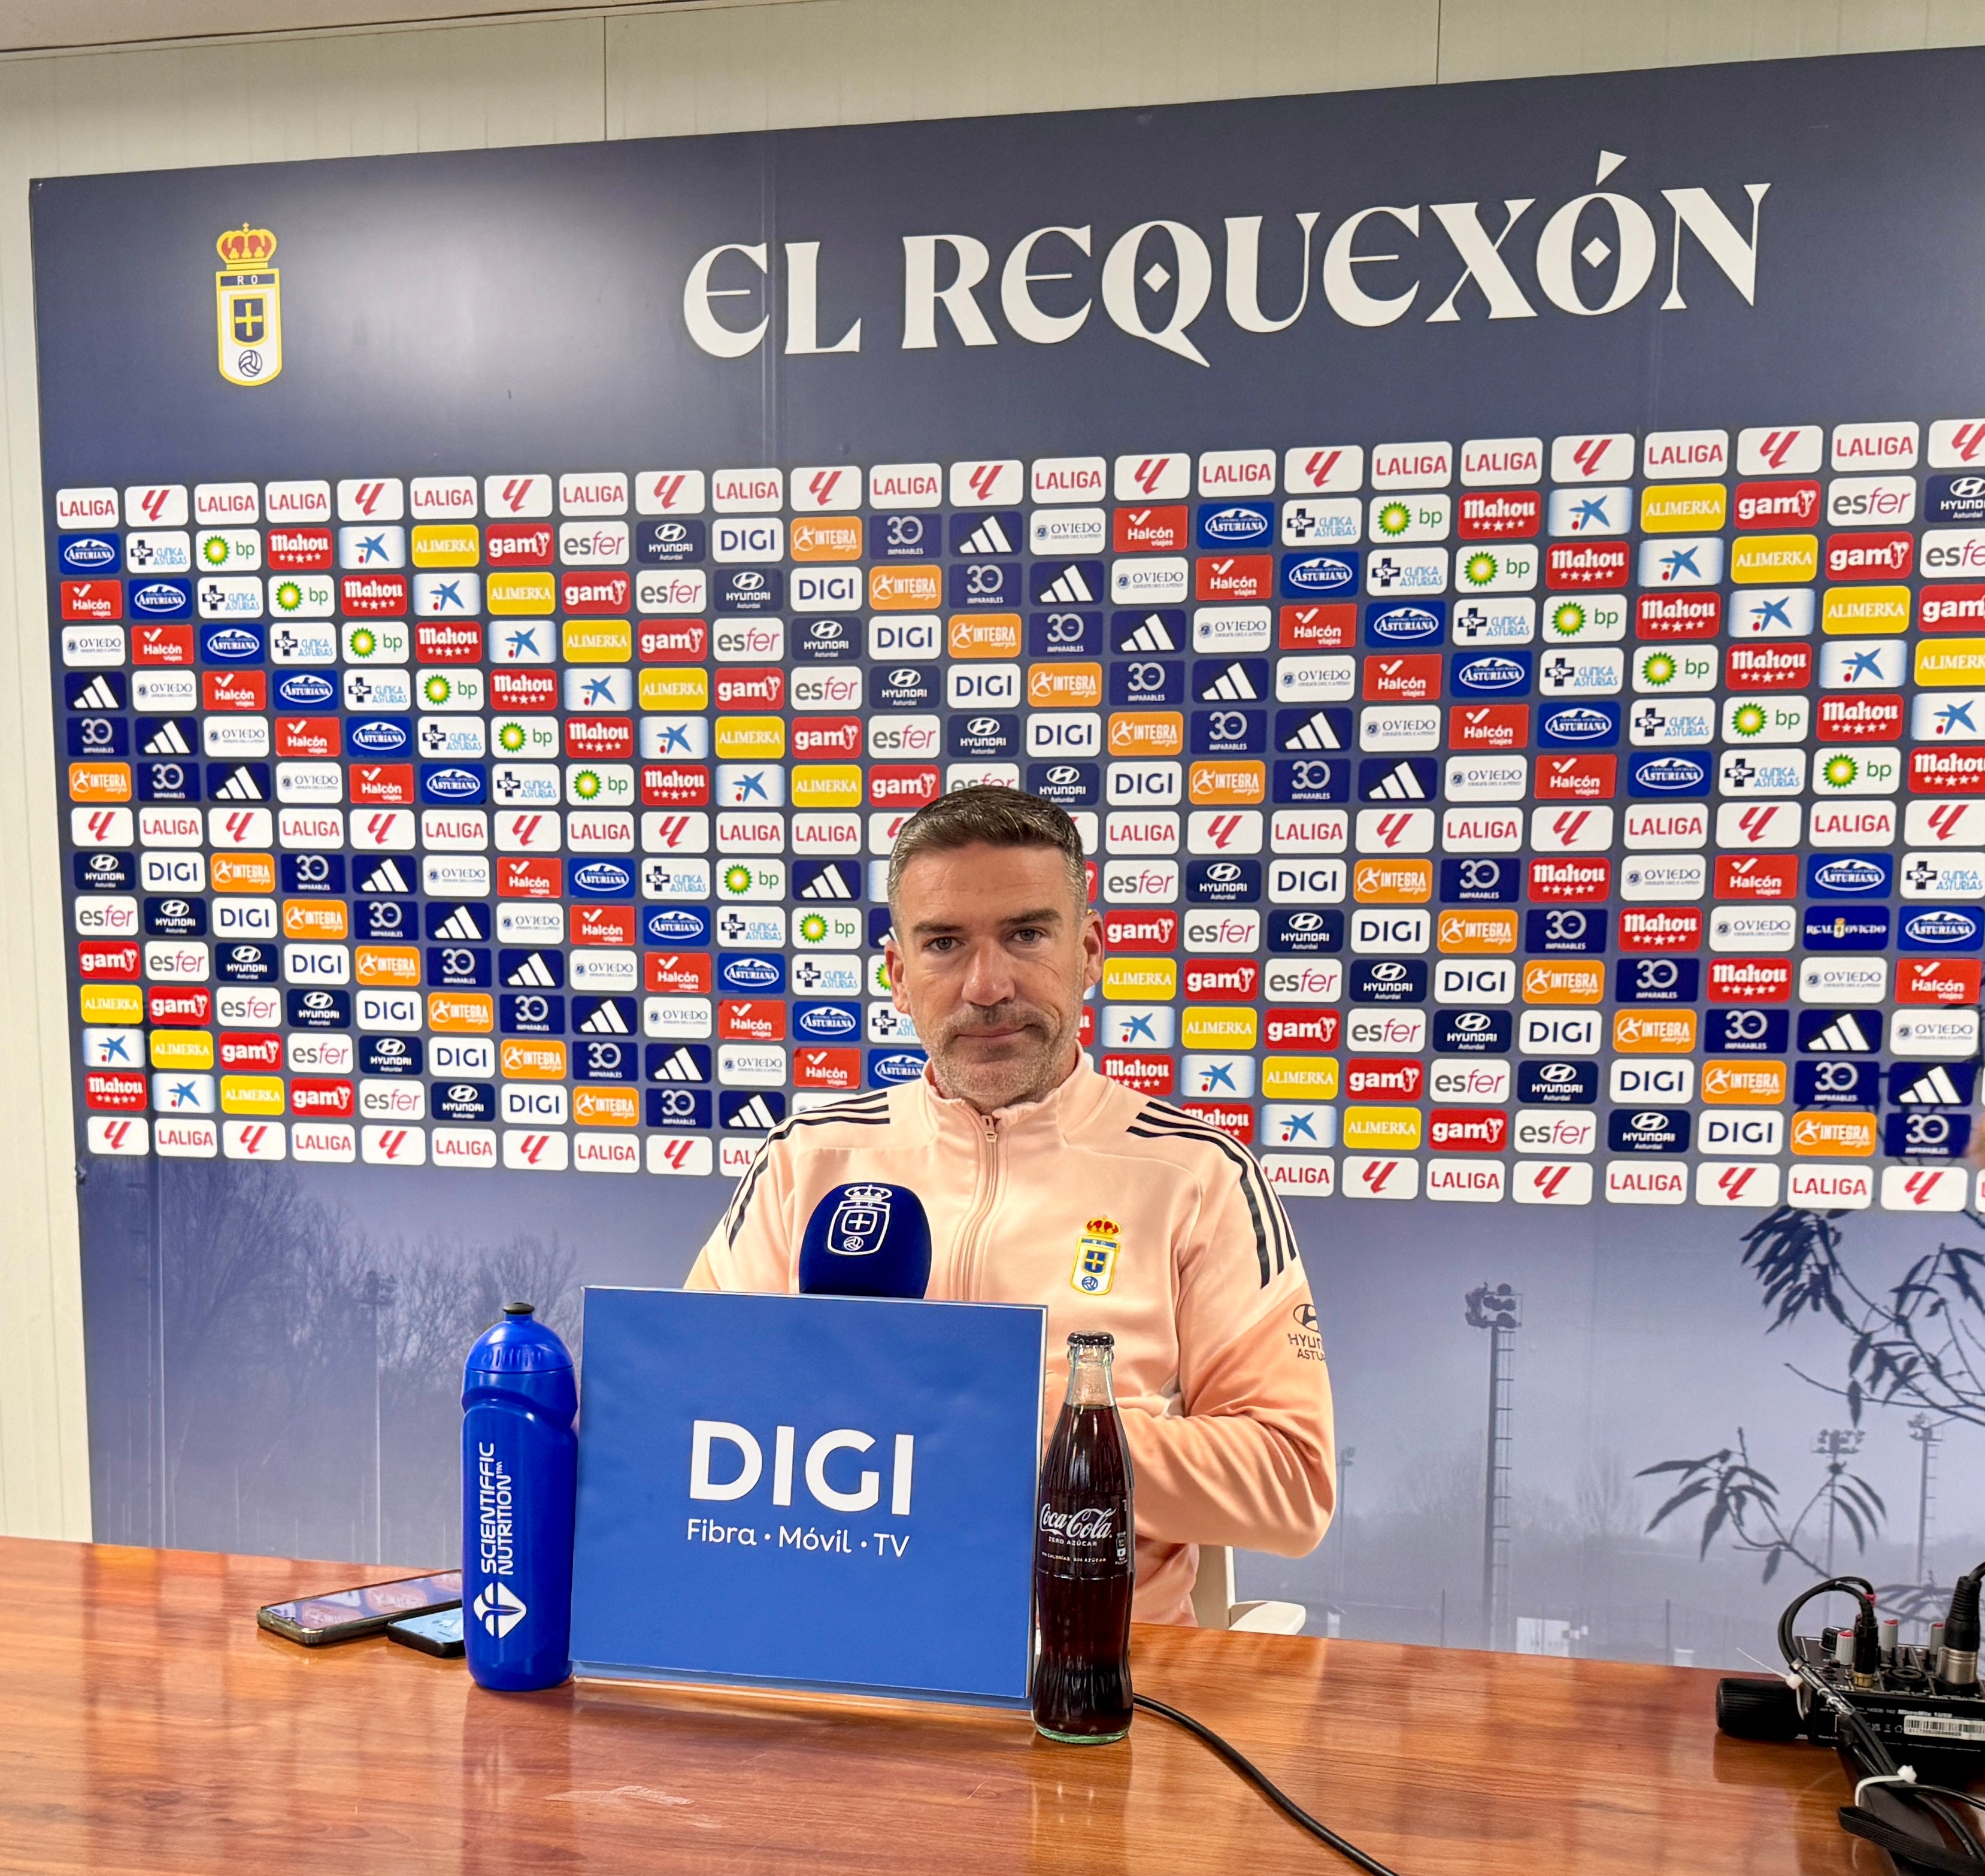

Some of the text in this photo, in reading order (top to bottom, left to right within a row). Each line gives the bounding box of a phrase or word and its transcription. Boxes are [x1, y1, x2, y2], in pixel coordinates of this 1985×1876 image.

[683, 150, 1771, 368] EL REQUEXÓN
[1648, 444, 1723, 465] LALIGA
[1836, 436, 1913, 457] LALIGA
[1465, 451, 1538, 472] LALIGA
[1035, 471, 1102, 490] LALIGA
[1202, 463, 1271, 484] LALIGA
[563, 486, 624, 503] LALIGA
[873, 477, 938, 496] LALIGA
[198, 495, 255, 513] LALIGA
[1464, 498, 1535, 523] Mahou
[1646, 500, 1722, 517] ALIMERKA
[1832, 487, 1911, 516] esfer
[1208, 520, 1262, 533] ASTURIANA
[1420, 508, 1442, 529] bp
[1051, 523, 1102, 536] OVIEDO
[1128, 528, 1174, 540] Halcón
[1314, 526, 1356, 537] ASTURIAS
[416, 539, 476, 553] ALIMERKA
[563, 531, 625, 556] esfer
[648, 543, 693, 552] HYUNDAI
[720, 529, 775, 551] DIGI
[66, 549, 111, 560] ASTURIANA
[237, 541, 255, 560] bp
[1736, 550, 1814, 568] ALIMERKA
[1507, 558, 1531, 579] bp
[1551, 548, 1624, 573] Mahou
[640, 579, 702, 604] esfer
[799, 578, 854, 601] DIGI
[72, 600, 110, 610] Halcón
[1642, 599, 1715, 623] Mahou
[1828, 602, 1905, 619] ALIMERKA
[1214, 620, 1267, 634] OVIEDO
[1294, 625, 1341, 638] Halcón
[1376, 619, 1434, 632] ASTURIANA
[79, 638, 122, 648] OVIEDO
[208, 639, 255, 651] ASTURIANA
[384, 634, 402, 653] bp
[419, 625, 480, 649] Mahou
[717, 627, 780, 652] esfer
[877, 626, 933, 648] DIGI
[1686, 658, 1710, 679] bp
[1732, 650, 1806, 674] Mahou
[643, 682, 704, 696] ALIMERKA
[956, 675, 1012, 697] DIGI
[1053, 675, 1096, 690] INTEGRA
[882, 689, 927, 698] HYUNDAI
[1823, 701, 1898, 726] Mahou
[222, 729, 265, 738] OVIEDO
[1035, 724, 1092, 745] DIGI
[1134, 725, 1177, 740] INTEGRA
[1382, 720, 1436, 731] OVIEDO
[1464, 726, 1513, 739] Halcón
[1548, 719, 1608, 732] ASTURIANA
[287, 737, 327, 747] Halcón
[872, 725, 936, 749] esfer
[960, 737, 1006, 746] HYUNDAI
[1868, 760, 1892, 781] bp
[609, 776, 628, 795] bp
[645, 769, 704, 792] Mahou
[796, 779, 858, 793] ALIMERKA
[1115, 772, 1173, 795] DIGI
[425, 822, 484, 838] LALIGA
[1629, 817, 1702, 836] LALIGA
[1814, 814, 1890, 833] LALIGA
[1110, 825, 1175, 842] LALIGA
[85, 872, 125, 881] HYUNDAI
[148, 862, 198, 882] DIGI
[232, 864, 271, 879] INTEGRA
[441, 869, 486, 878] OVIEDO
[577, 873, 625, 885] ASTURIANA
[1534, 863, 1605, 887] Mahou
[1644, 869, 1701, 880] OVIEDO
[1819, 871, 1879, 884] ASTURIANA
[1108, 869, 1174, 894] esfer
[1199, 883, 1247, 892] HYUNDAI
[1277, 870, 1337, 892] DIGI
[1730, 876, 1781, 887] Halcón
[79, 905, 134, 928] esfer
[835, 919, 856, 938] bp
[1465, 922, 1511, 938] INTEGRA
[292, 954, 342, 974] DIGI
[1107, 972, 1172, 986] ALIMERKA
[1269, 968, 1338, 993] esfer
[1444, 971, 1506, 992] DIGI
[1550, 972, 1598, 989] INTEGRA
[1713, 962, 1787, 986] Mahou
[1823, 972, 1881, 982] OVIEDO
[1363, 983, 1412, 992] HYUNDAI
[1912, 980, 1964, 991] Halcón
[84, 998, 140, 1010] ALIMERKA
[220, 996, 277, 1019] esfer
[662, 1010, 708, 1020] OVIEDO
[1447, 1033, 1496, 1042] HYUNDAI
[1642, 1022, 1690, 1038] INTEGRA
[1915, 1024, 1973, 1035] OVIEDO
[1724, 1042, 1768, 1050] IMPARABLES
[437, 1047, 487, 1068] DIGI
[1266, 1071, 1334, 1085] ALIMERKA
[1435, 1068, 1505, 1093] esfer
[1619, 1070, 1684, 1092] DIGI
[225, 1089, 281, 1102] ALIMERKA
[1532, 1083, 1583, 1093] HYUNDAI
[364, 1089, 421, 1111] esfer
[509, 1094, 560, 1114] DIGI
[158, 1130, 214, 1146] LALIGA
[1519, 1120, 1591, 1145] esfer
[1623, 1132, 1675, 1141] HYUNDAI
[1820, 1125, 1869, 1141] INTEGRA
[435, 1139, 493, 1156] LALIGA
[1431, 1171, 1500, 1190] LALIGA
[1792, 1177, 1867, 1196] LALIGA
[1298, 1348, 1325, 1361] ASTU
[690, 1420, 914, 1515] DIGI
[479, 1442, 496, 1574] SCIENTIFFIC
[687, 1519, 910, 1556] Fibra Móvil TV
